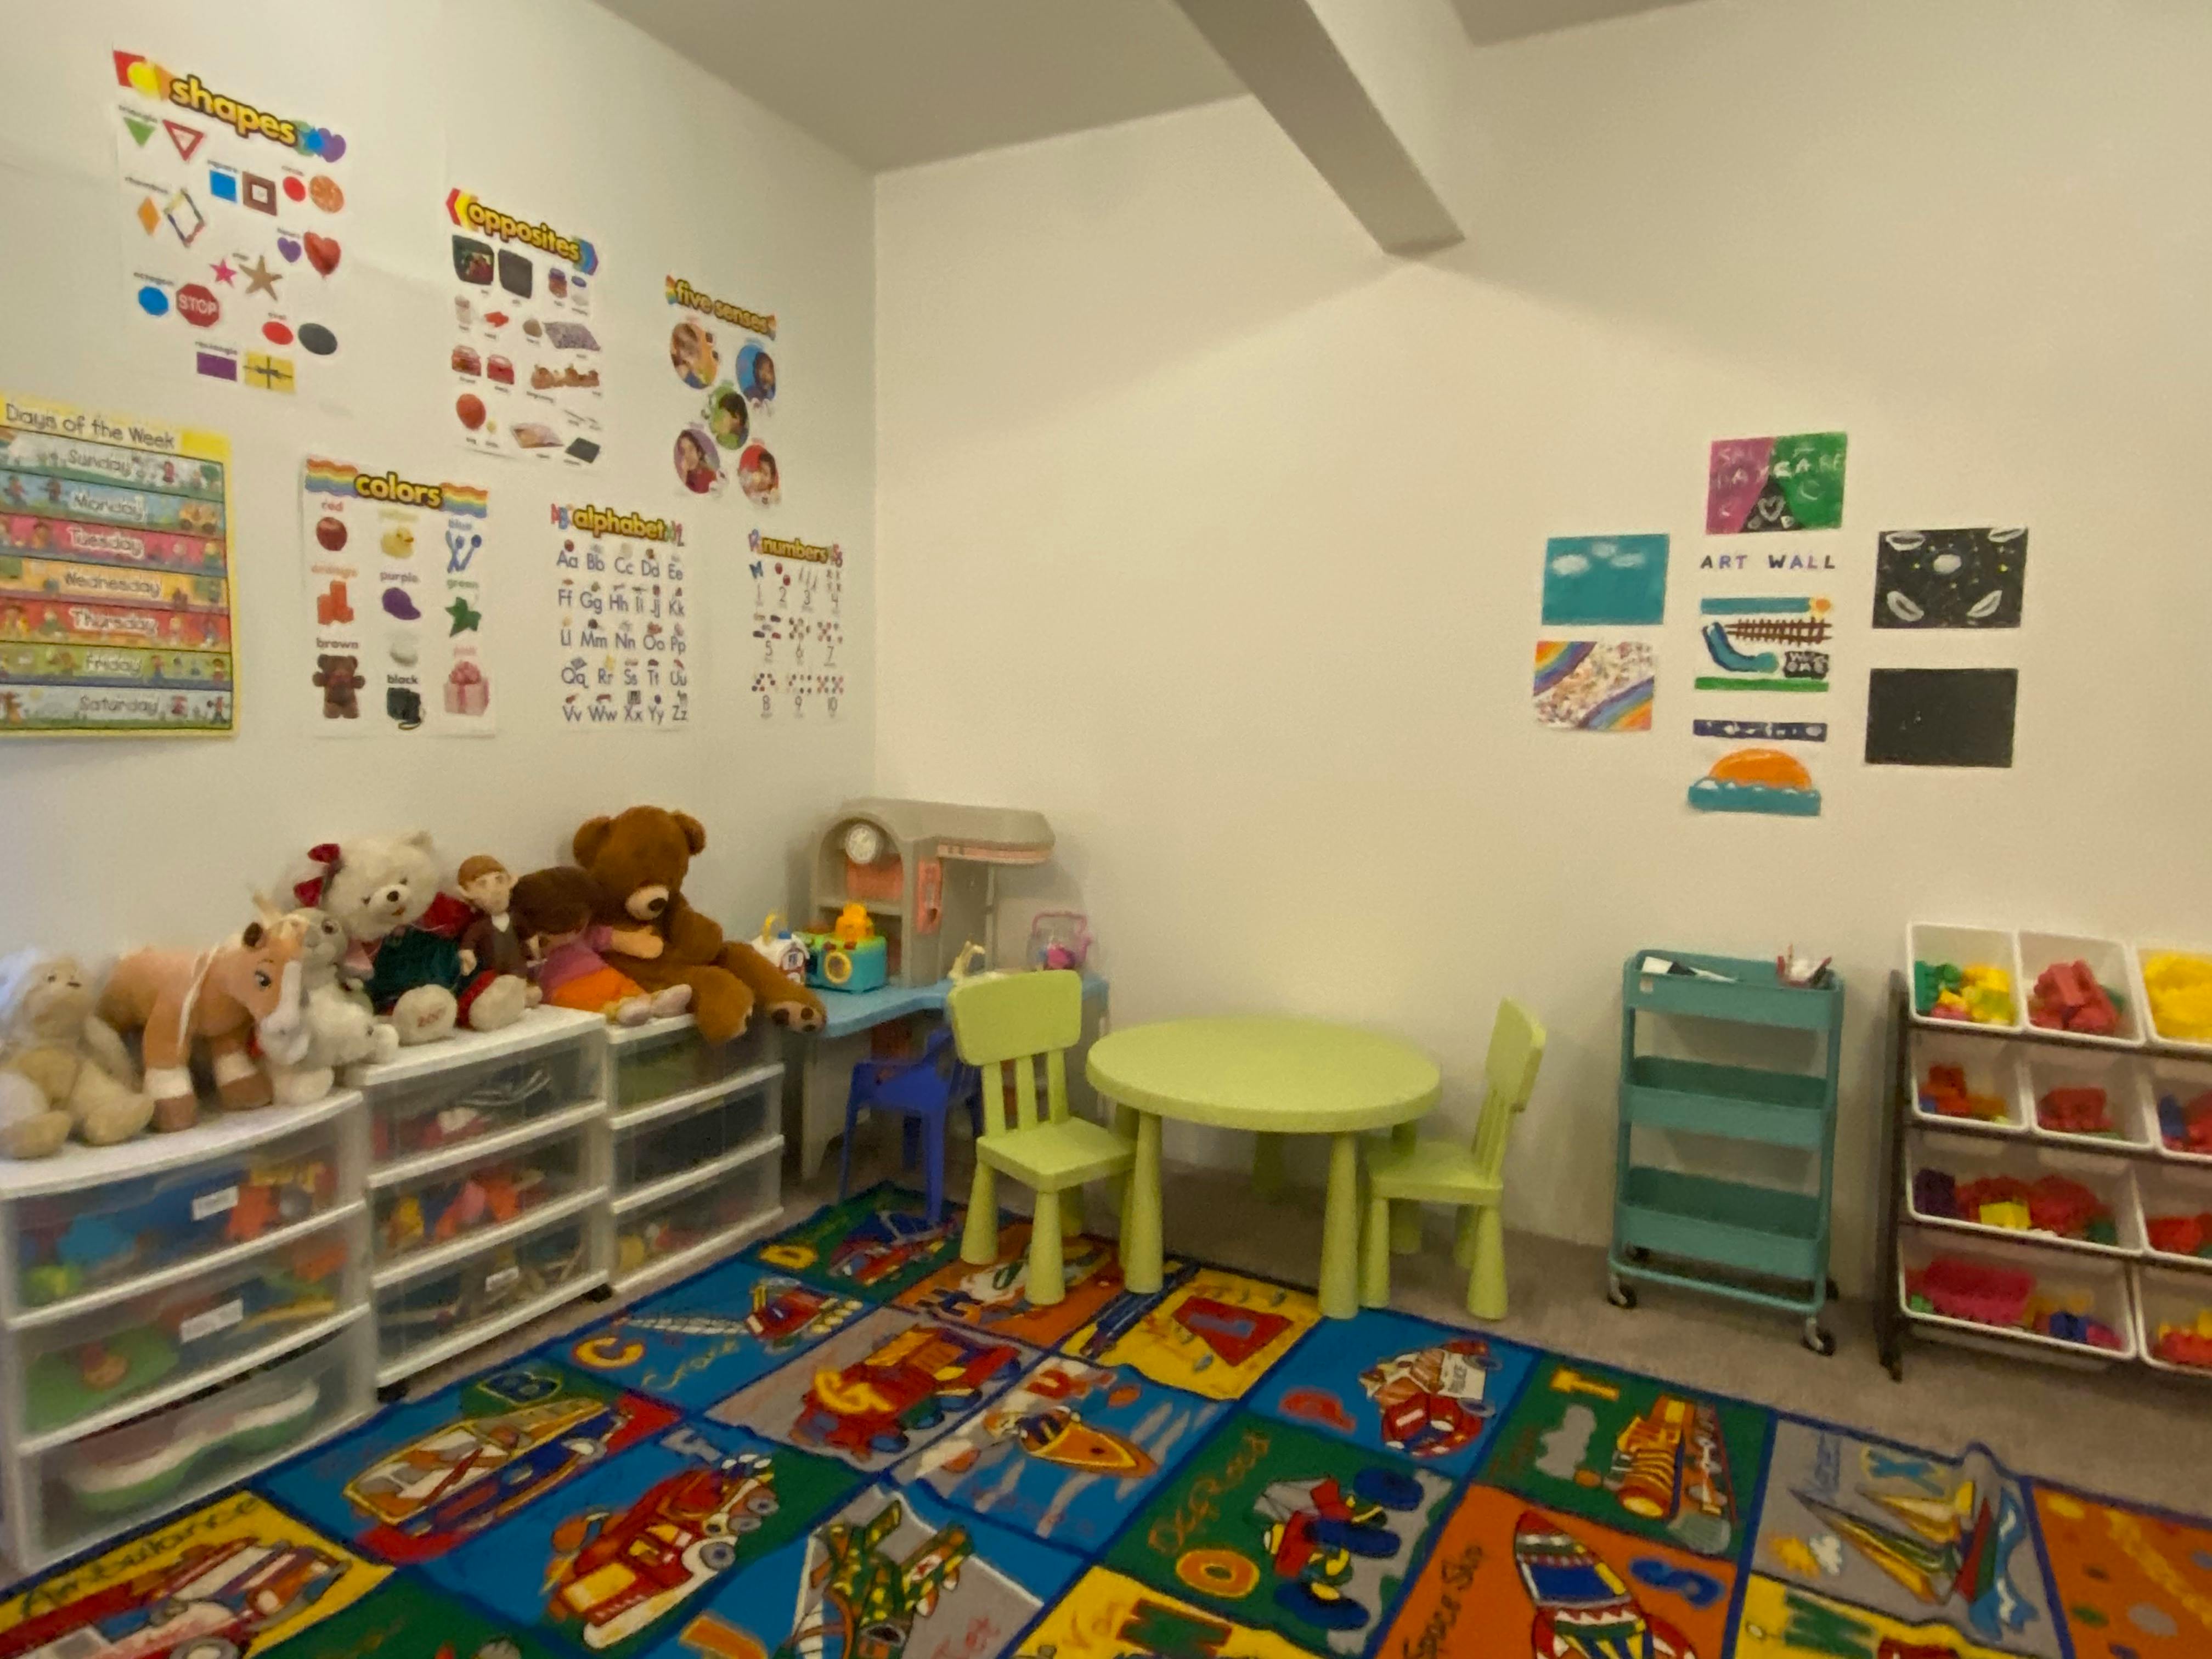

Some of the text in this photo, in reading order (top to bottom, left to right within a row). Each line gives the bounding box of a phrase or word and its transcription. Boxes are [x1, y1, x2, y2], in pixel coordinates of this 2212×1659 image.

[169, 74, 297, 148] shapes
[467, 202, 580, 263] opposites
[178, 295, 217, 315] STOP
[675, 279, 770, 335] five senses
[6, 403, 175, 449] Days of the Week
[69, 449, 132, 477] Sunday
[354, 471, 443, 509] colors
[74, 492, 145, 521] Monday
[573, 504, 668, 542] alphabet
[1700, 555, 1836, 569] ART WALL
[316, 637, 359, 649] brown
[387, 674, 419, 685] black
[80, 695, 159, 716] Saturday
